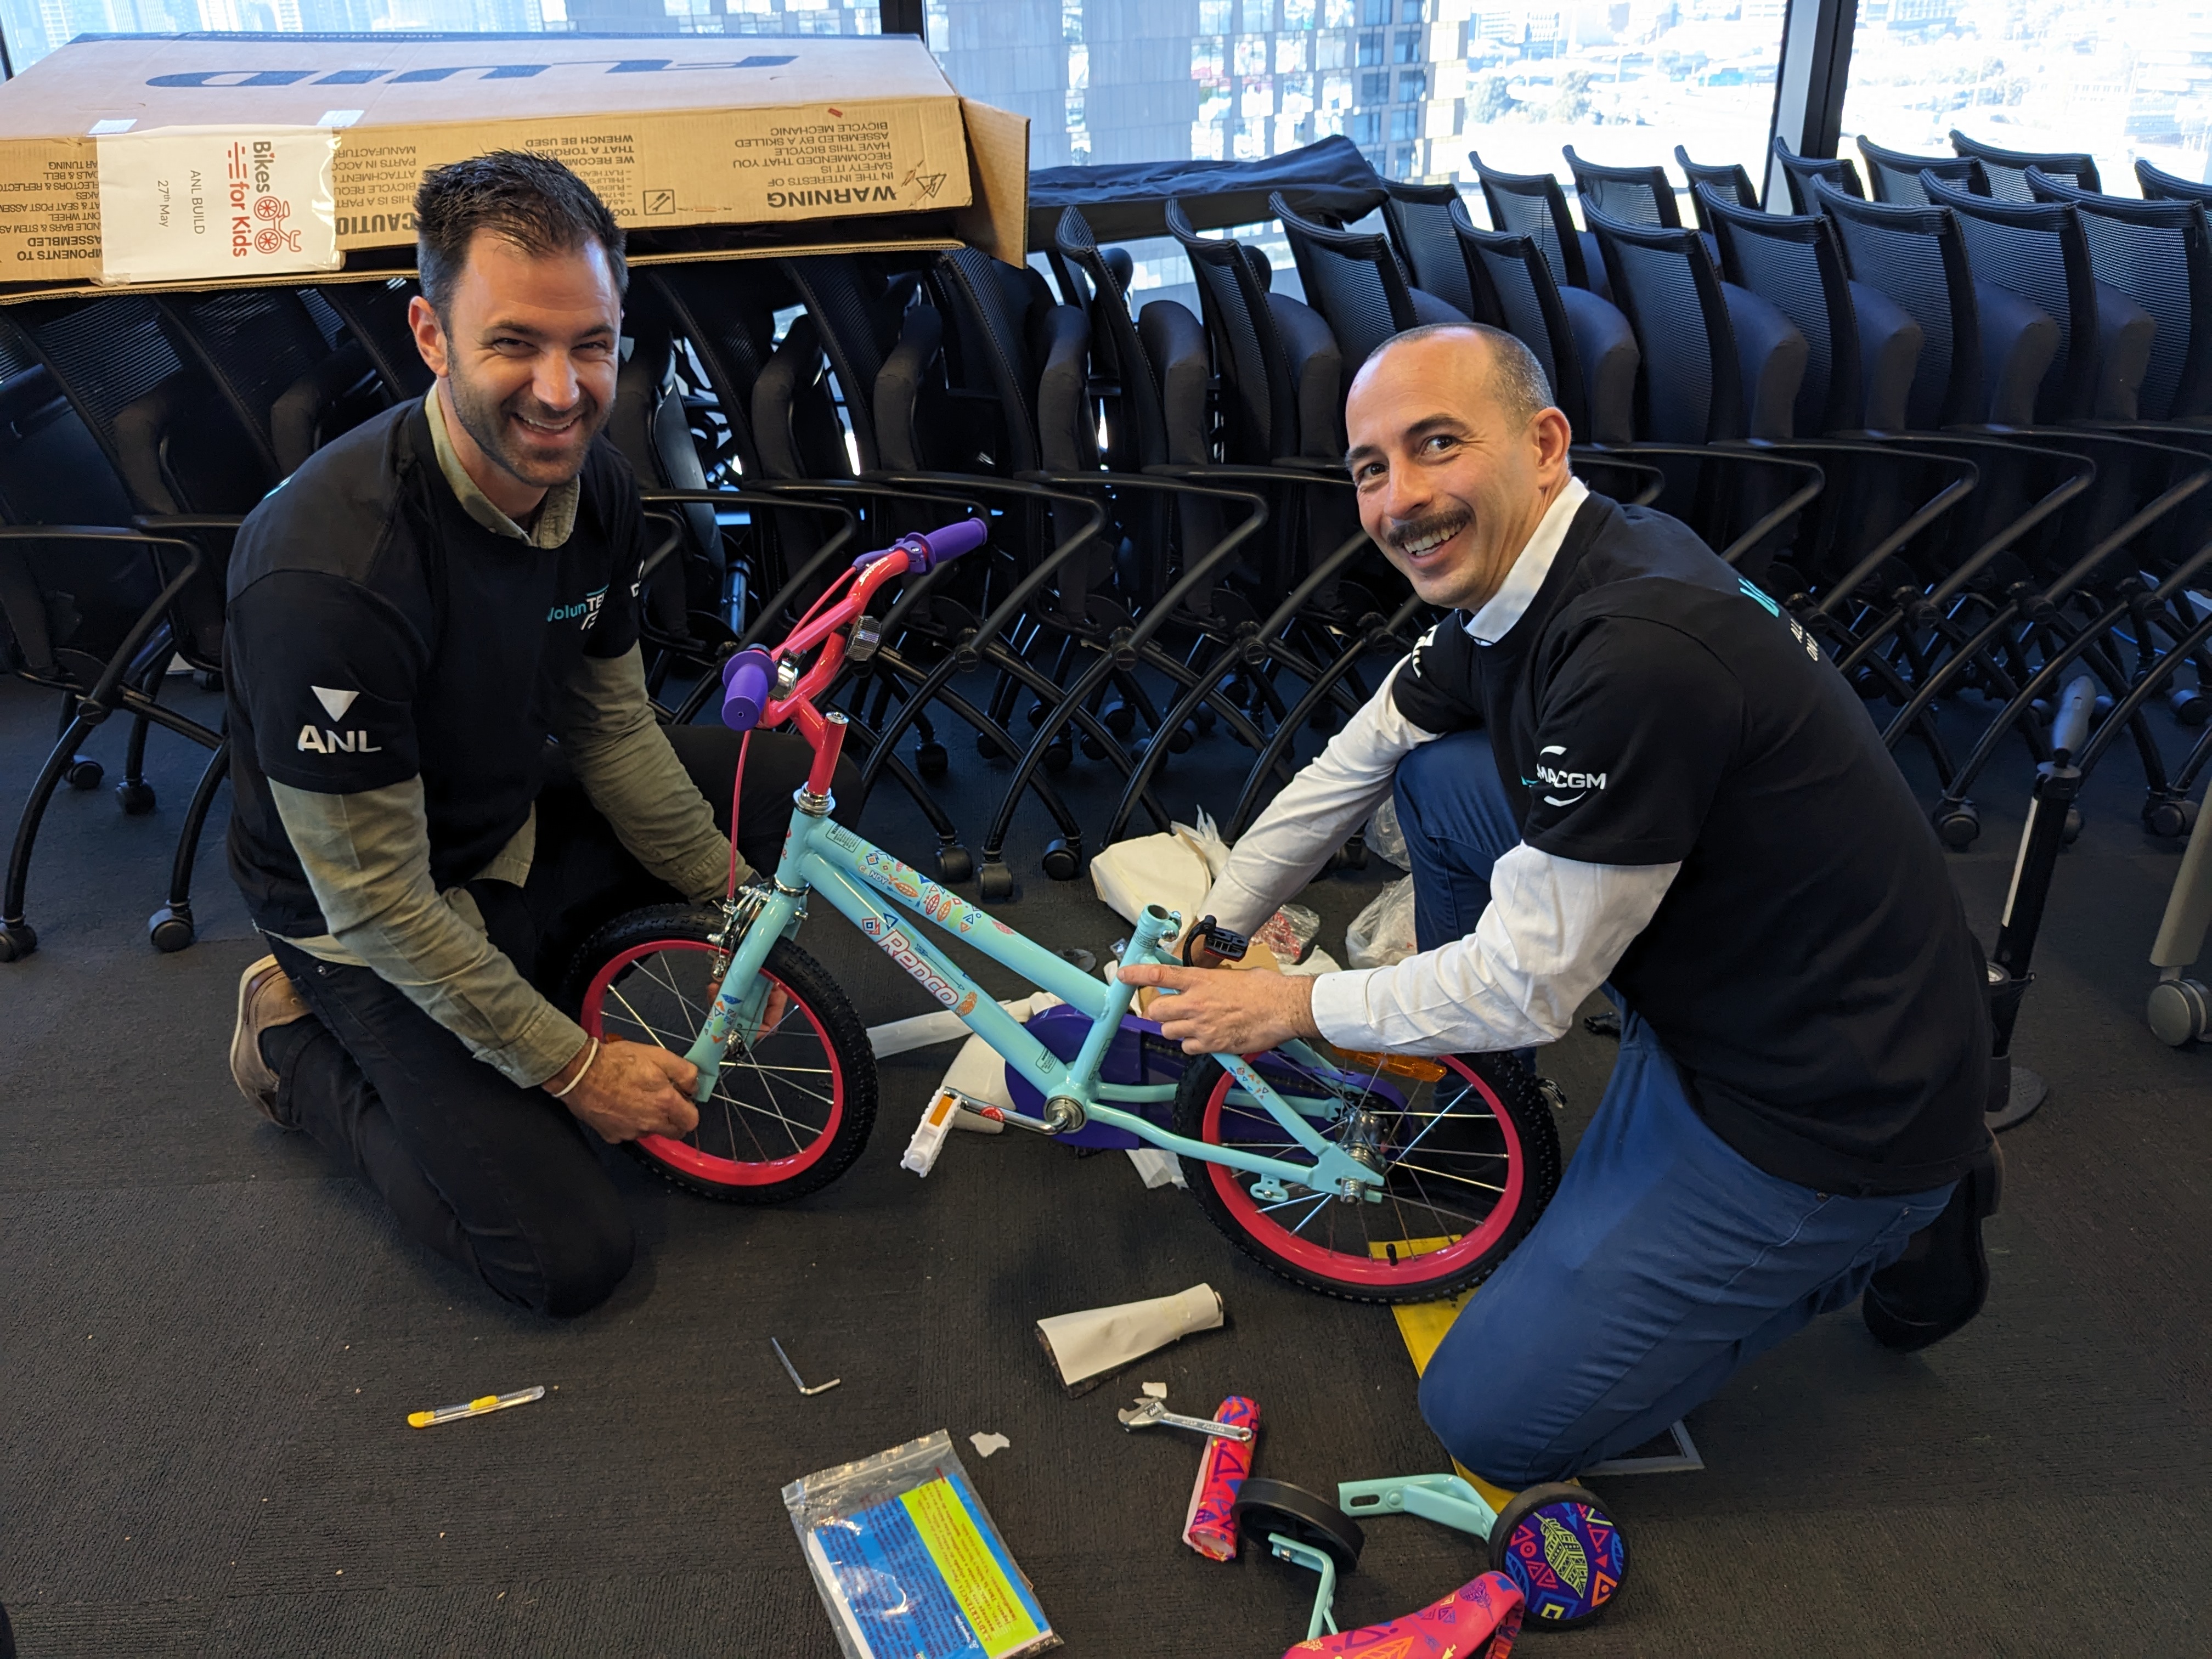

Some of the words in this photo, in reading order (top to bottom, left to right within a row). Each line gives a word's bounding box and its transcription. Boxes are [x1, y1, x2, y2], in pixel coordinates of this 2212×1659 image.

[145, 55, 799, 88] FLUID
[770, 125, 834, 136] MECHANIC
[838, 122, 888, 134] BICYCLE
[580, 135, 633, 144] WRENCH
[799, 136, 814, 145] BY
[818, 132, 889, 143] ASSEMBLED
[526, 138, 557, 147] USED
[735, 138, 784, 148] SKILLED
[859, 142, 890, 151] HAVE
[538, 148, 588, 156] TORQUE
[602, 145, 634, 154] THAT
[775, 146, 826, 155] BICYCLE
[829, 144, 856, 153] THIS
[380, 158, 416, 167] PARTS
[616, 156, 635, 164] WE
[763, 157, 793, 167] THAT
[797, 152, 891, 165] RECOMMENDED
[48, 161, 83, 170] TUNING
[253, 142, 275, 193] Bikes
[732, 159, 759, 168] YOU
[849, 162, 893, 171] SAFETY
[340, 170, 416, 183] ATTACHMENT
[788, 174, 851, 185] INTERESTS
[855, 173, 879, 182] THE
[882, 172, 894, 180] IN
[190, 170, 201, 194] ANL
[768, 178, 785, 187] OF
[44, 183, 51, 191] &
[157, 180, 171, 202] 27th
[368, 182, 415, 193] BICYCLE
[229, 182, 250, 210] for
[378, 196, 388, 205] IS
[391, 195, 414, 204] THIS
[767, 186, 896, 208] WARNING
[56, 202, 78, 211] SEAT
[48, 213, 80, 221] WHEEL
[159, 205, 170, 227] May
[191, 198, 205, 234] BUILD
[14, 224, 38, 233] STEM
[49, 223, 74, 232] BARS
[27, 235, 101, 247] ASSEMBLED
[232, 217, 252, 257] Kids
[17, 251, 34, 261] TO
[297, 724, 382, 754] ANL
